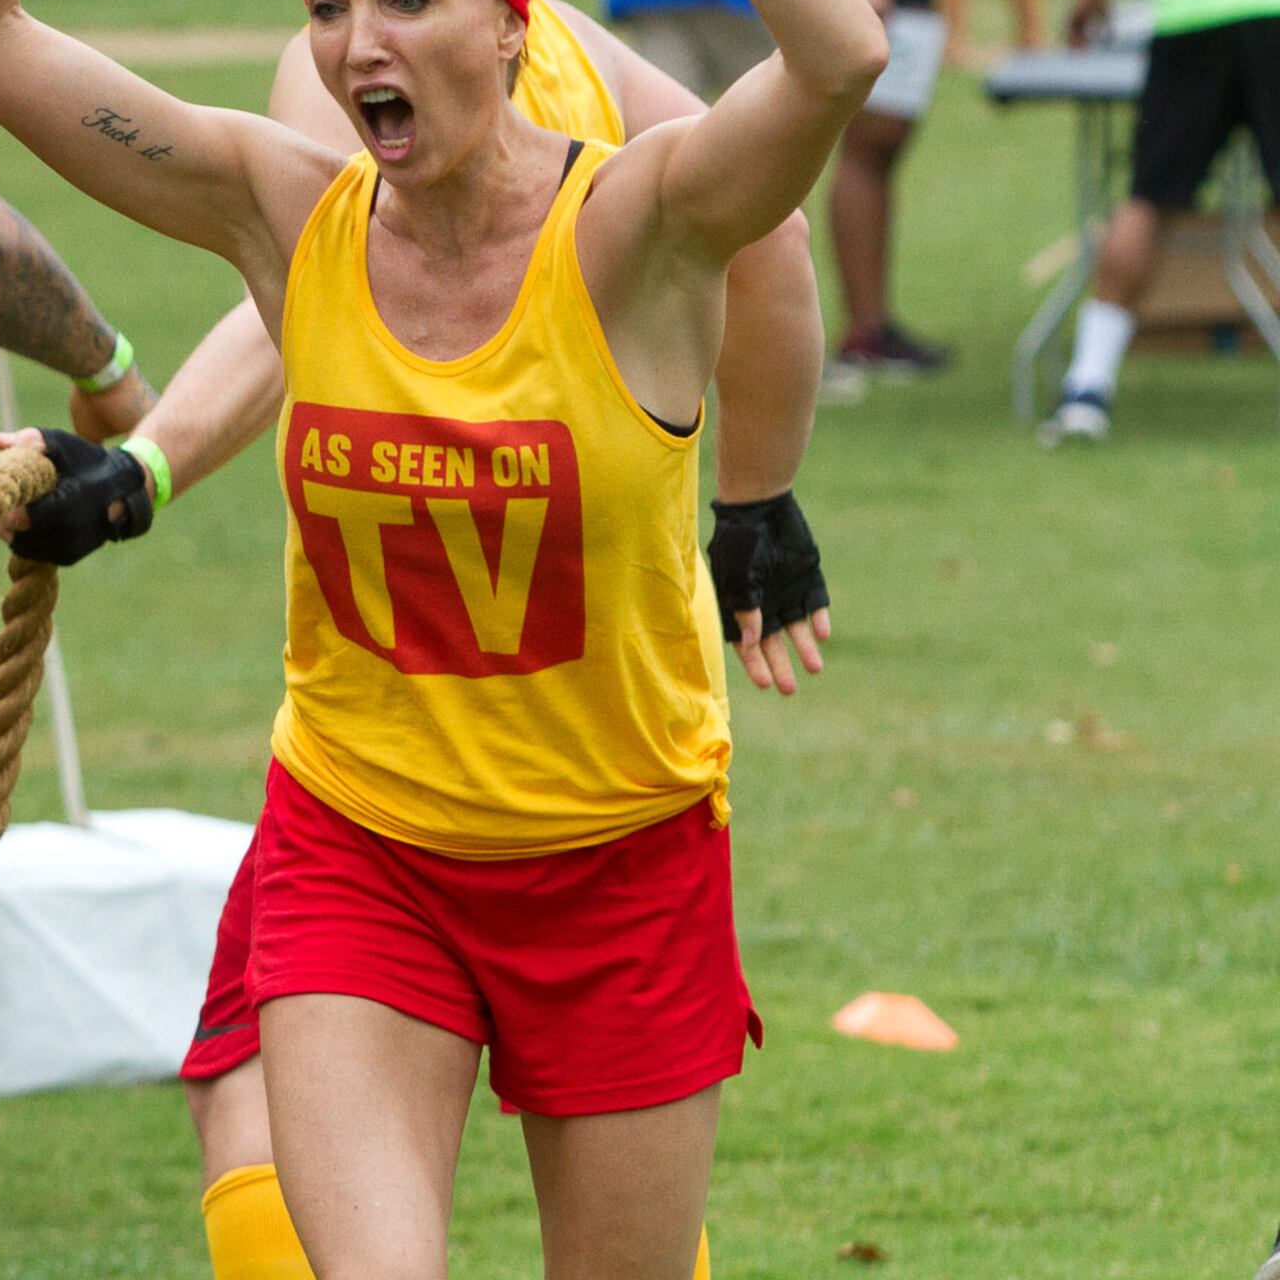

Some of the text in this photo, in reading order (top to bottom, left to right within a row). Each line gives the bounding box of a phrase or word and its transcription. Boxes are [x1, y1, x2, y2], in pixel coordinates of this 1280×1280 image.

[81, 107, 173, 161] Fuck it
[300, 427, 551, 488] AS SEEN ON
[302, 479, 549, 655] TV
